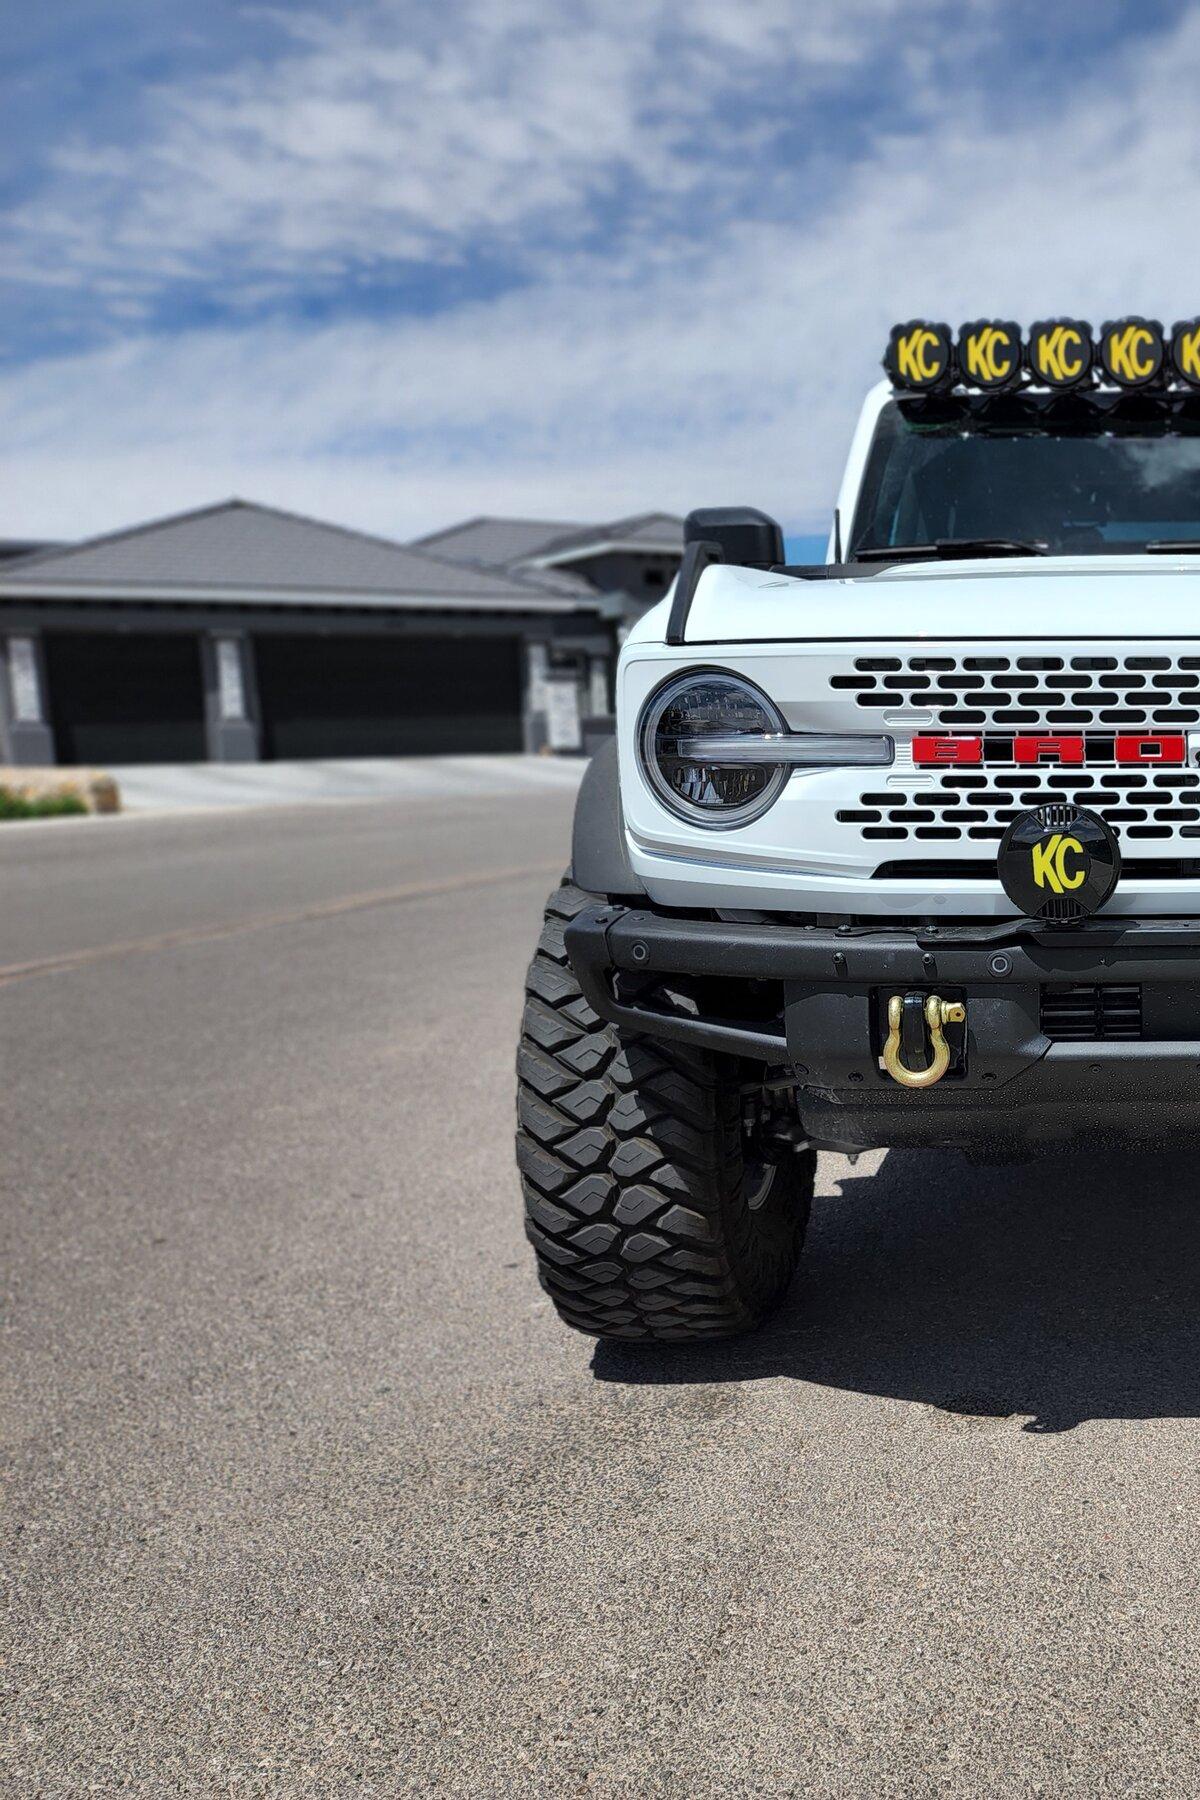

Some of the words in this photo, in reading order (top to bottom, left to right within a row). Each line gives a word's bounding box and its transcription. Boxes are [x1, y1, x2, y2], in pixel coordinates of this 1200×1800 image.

[897, 328, 940, 382] KC
[967, 327, 1010, 382] KC
[1037, 326, 1083, 381] KC
[1109, 325, 1154, 381] KC
[1031, 833, 1086, 894] KC
